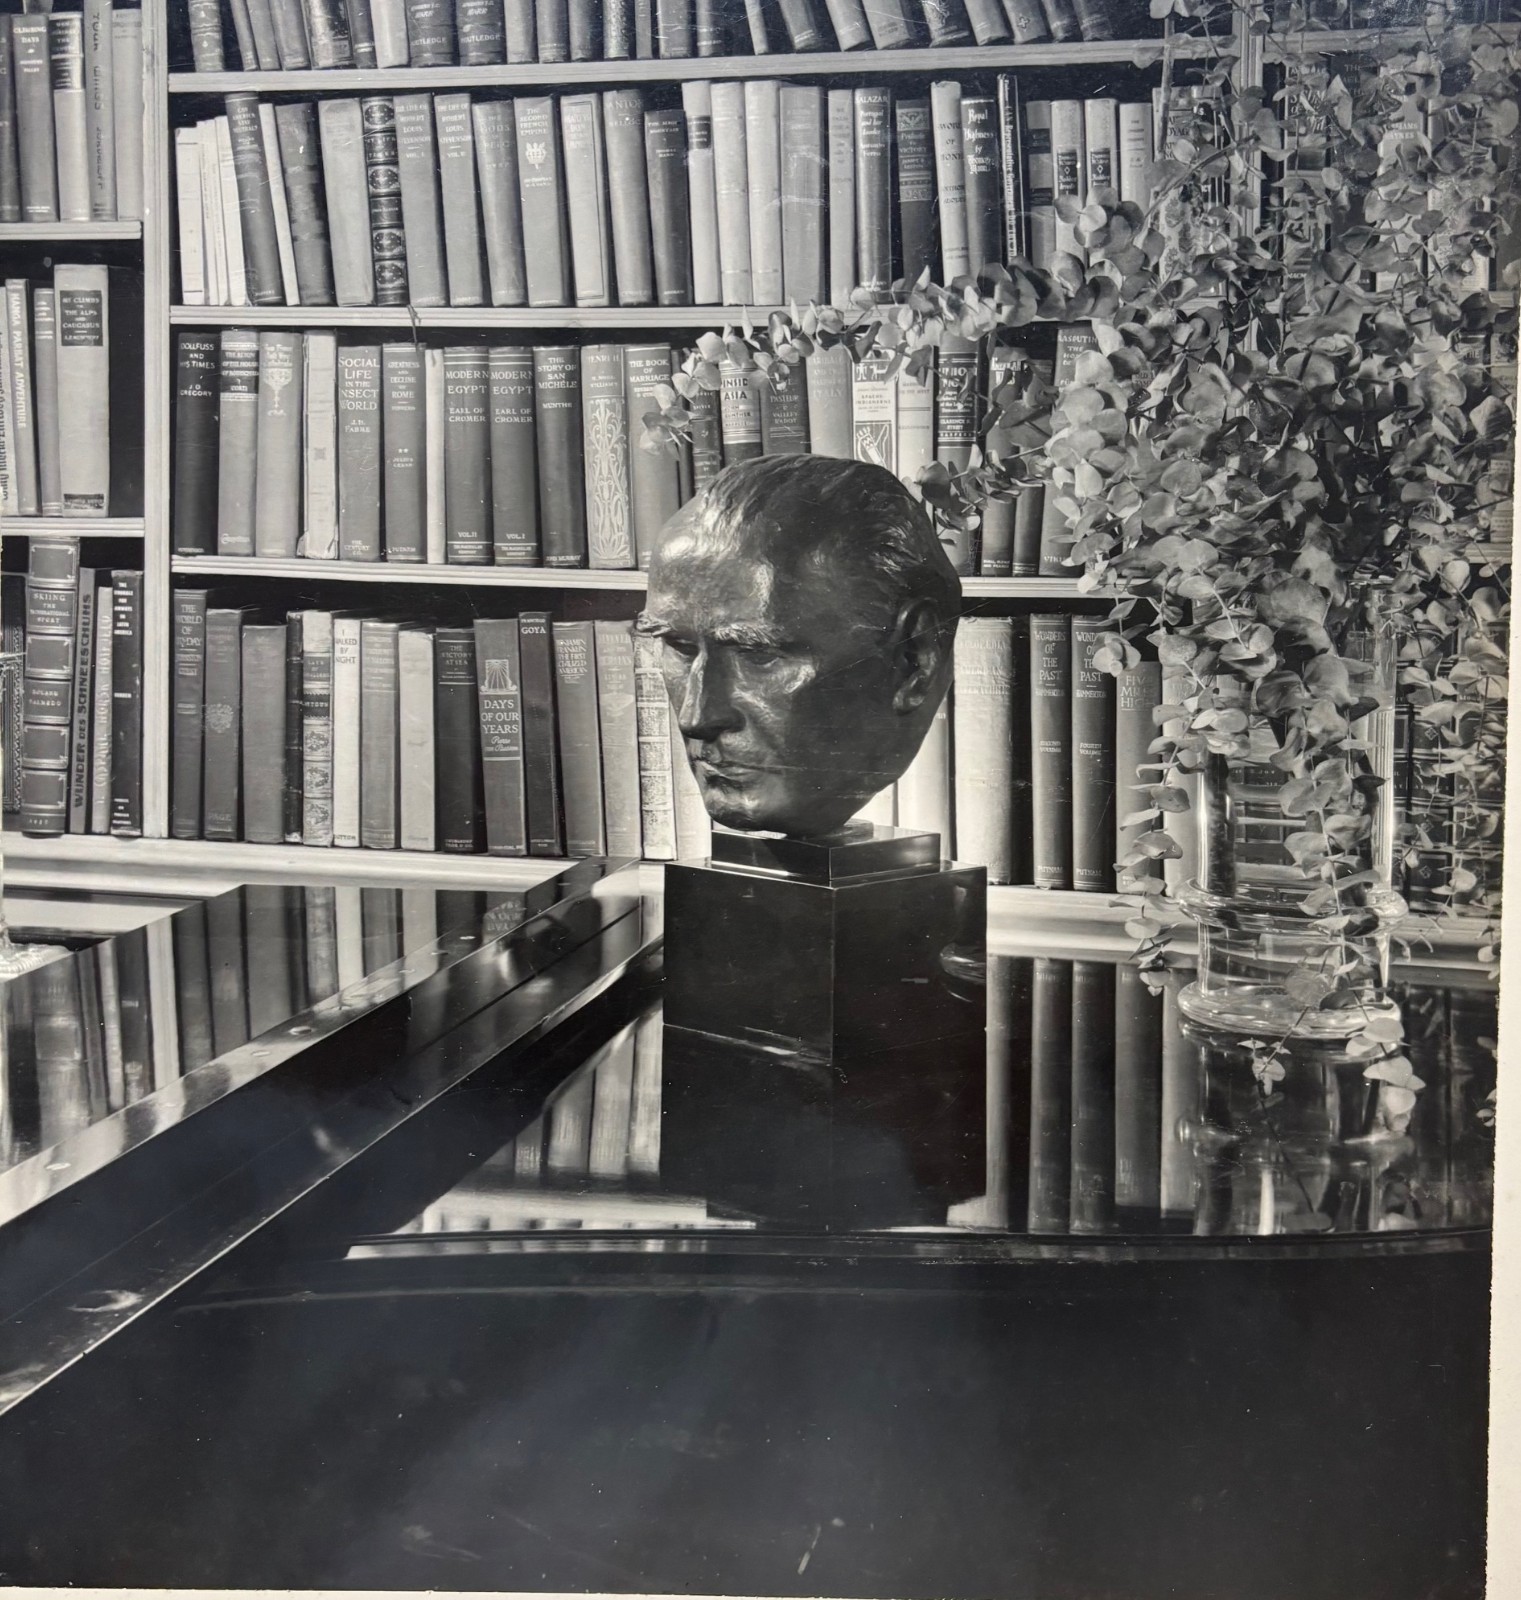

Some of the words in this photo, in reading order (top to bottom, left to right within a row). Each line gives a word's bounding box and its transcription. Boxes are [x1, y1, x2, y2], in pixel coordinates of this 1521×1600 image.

[967, 109, 988, 125] Royal
[180, 342, 215, 350] DOLLFUSS
[191, 360, 216, 369] TIMES
[338, 356, 381, 367] SOCIAL
[629, 360, 644, 368] THE
[344, 368, 372, 379] LIFE
[445, 370, 489, 379] MODERN
[491, 371, 533, 380] MODERN
[629, 374, 670, 382] MARRIAGE
[340, 389, 379, 398] NSECT
[447, 385, 487, 394] EGYPT
[493, 385, 534, 394] EGYPT
[391, 391, 415, 399] ROME
[724, 391, 748, 400] ASIA
[15, 371, 27, 429] ADVENTURE
[340, 400, 378, 411] WORLD
[33, 593, 66, 601] SKIING
[180, 604, 197, 613] THE
[181, 626, 193, 635] OF
[521, 626, 546, 634] GOYA
[1034, 630, 1066, 641] WONDERS
[1075, 631, 1096, 642] WOND
[1044, 642, 1057, 654] OF
[77, 593, 92, 715] SCHNEESCHUHS
[1042, 657, 1059, 668] THE
[1039, 671, 1063, 680] PAST
[1080, 671, 1103, 682] PAST
[484, 699, 515, 709] DAYS
[480, 712, 494, 721] OF
[495, 712, 520, 721] OUR
[78, 719, 87, 740] DES
[482, 724, 519, 734] YEARS
[74, 743, 85, 808] WUNDER
